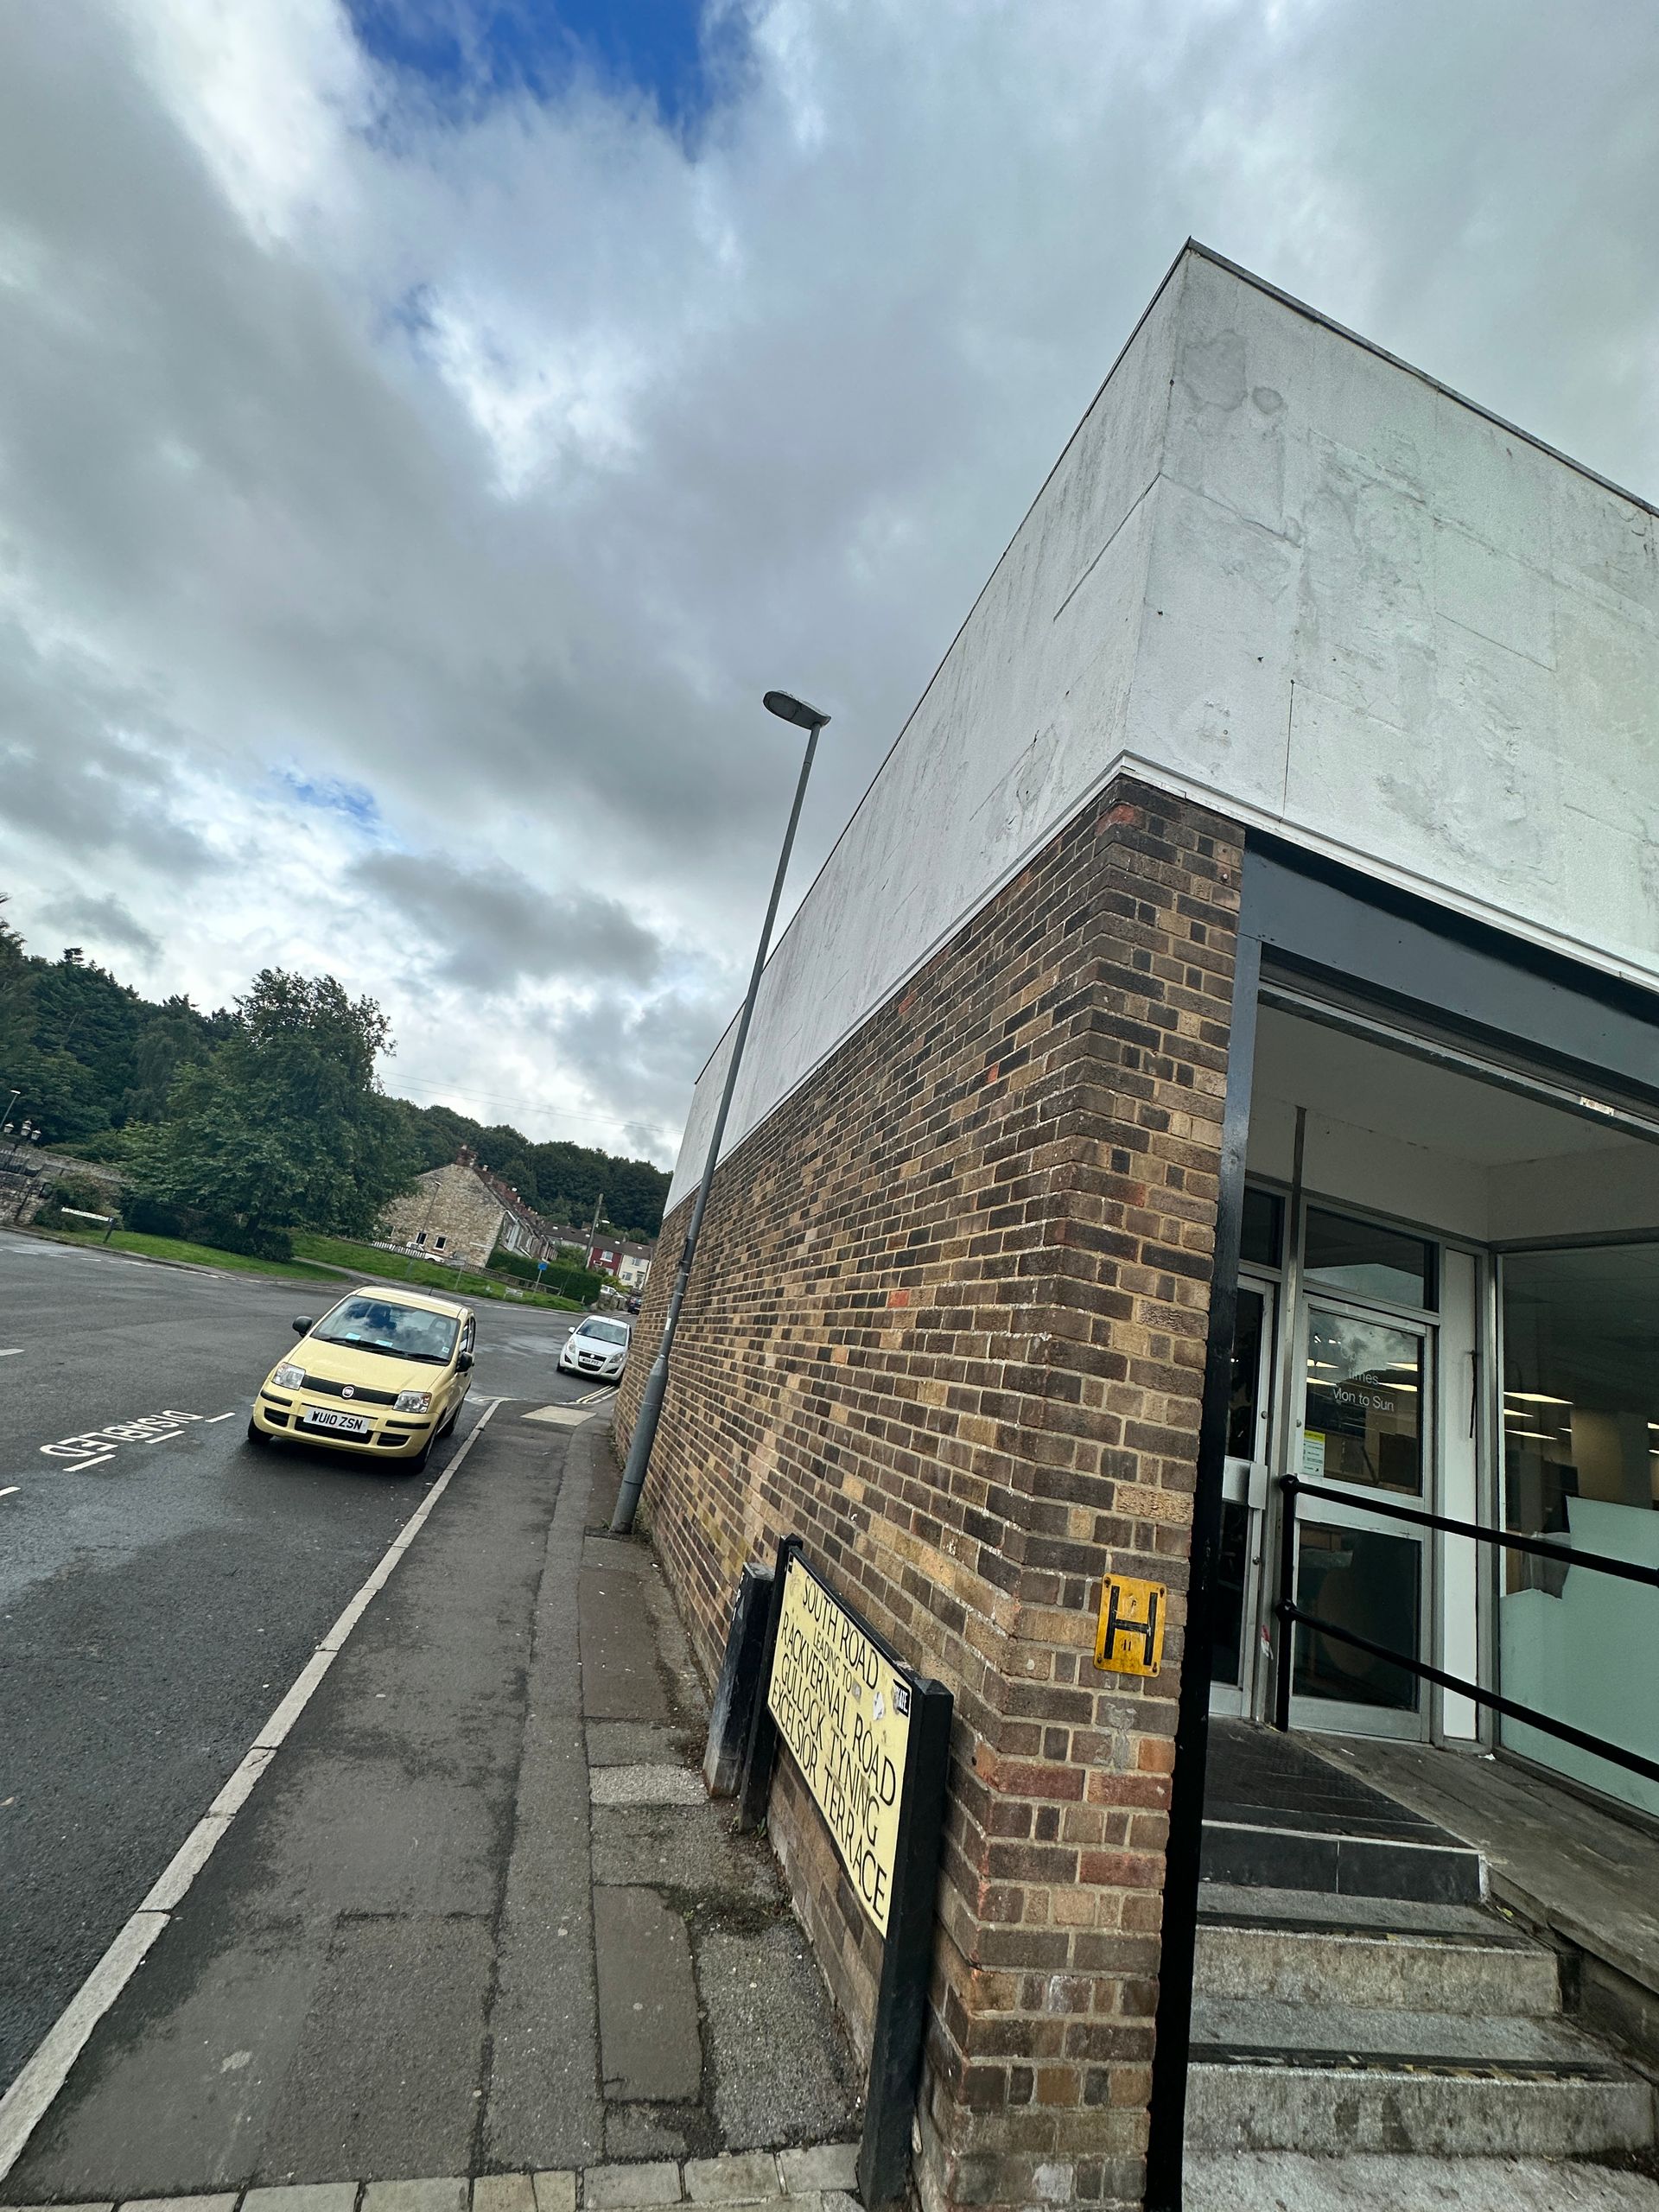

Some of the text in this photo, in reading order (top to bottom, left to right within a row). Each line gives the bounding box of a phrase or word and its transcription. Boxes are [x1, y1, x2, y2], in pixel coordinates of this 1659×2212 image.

[40, 1409, 204, 1458] DISABLED
[312, 1411, 363, 1430] WU10 ZSN
[1333, 1387, 1395, 1412] Mon to Sun
[803, 1575, 880, 1690] SOUTH ROAD
[813, 1627, 853, 1694] LEADING TO
[1104, 1586, 1158, 1666] H
[781, 1611, 896, 1807] RACKVERNAL ROAD
[781, 1653, 880, 1847] GULLOCK TYNING
[771, 1675, 887, 1921] EXCELSIOR TERRACE
